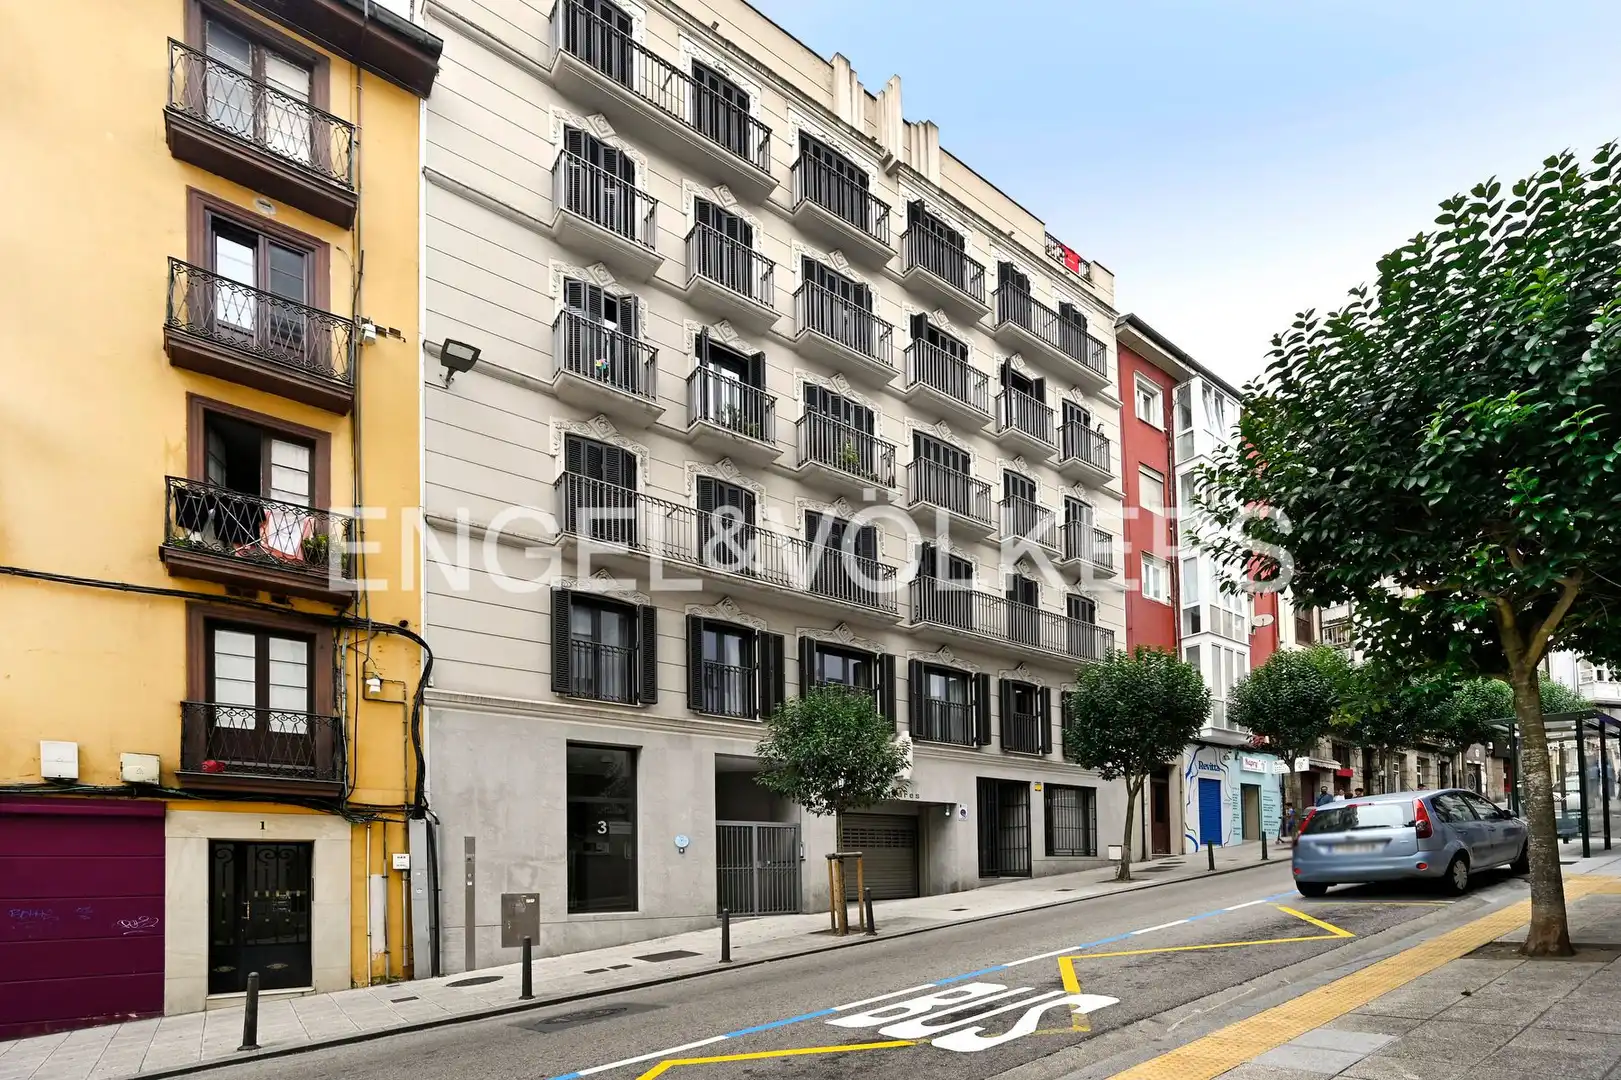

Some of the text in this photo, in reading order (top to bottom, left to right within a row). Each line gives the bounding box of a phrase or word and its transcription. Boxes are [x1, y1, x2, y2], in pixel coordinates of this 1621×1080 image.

[259, 820, 266, 831] 1
[597, 820, 607, 834] 3
[824, 982, 1121, 1053] BUS
